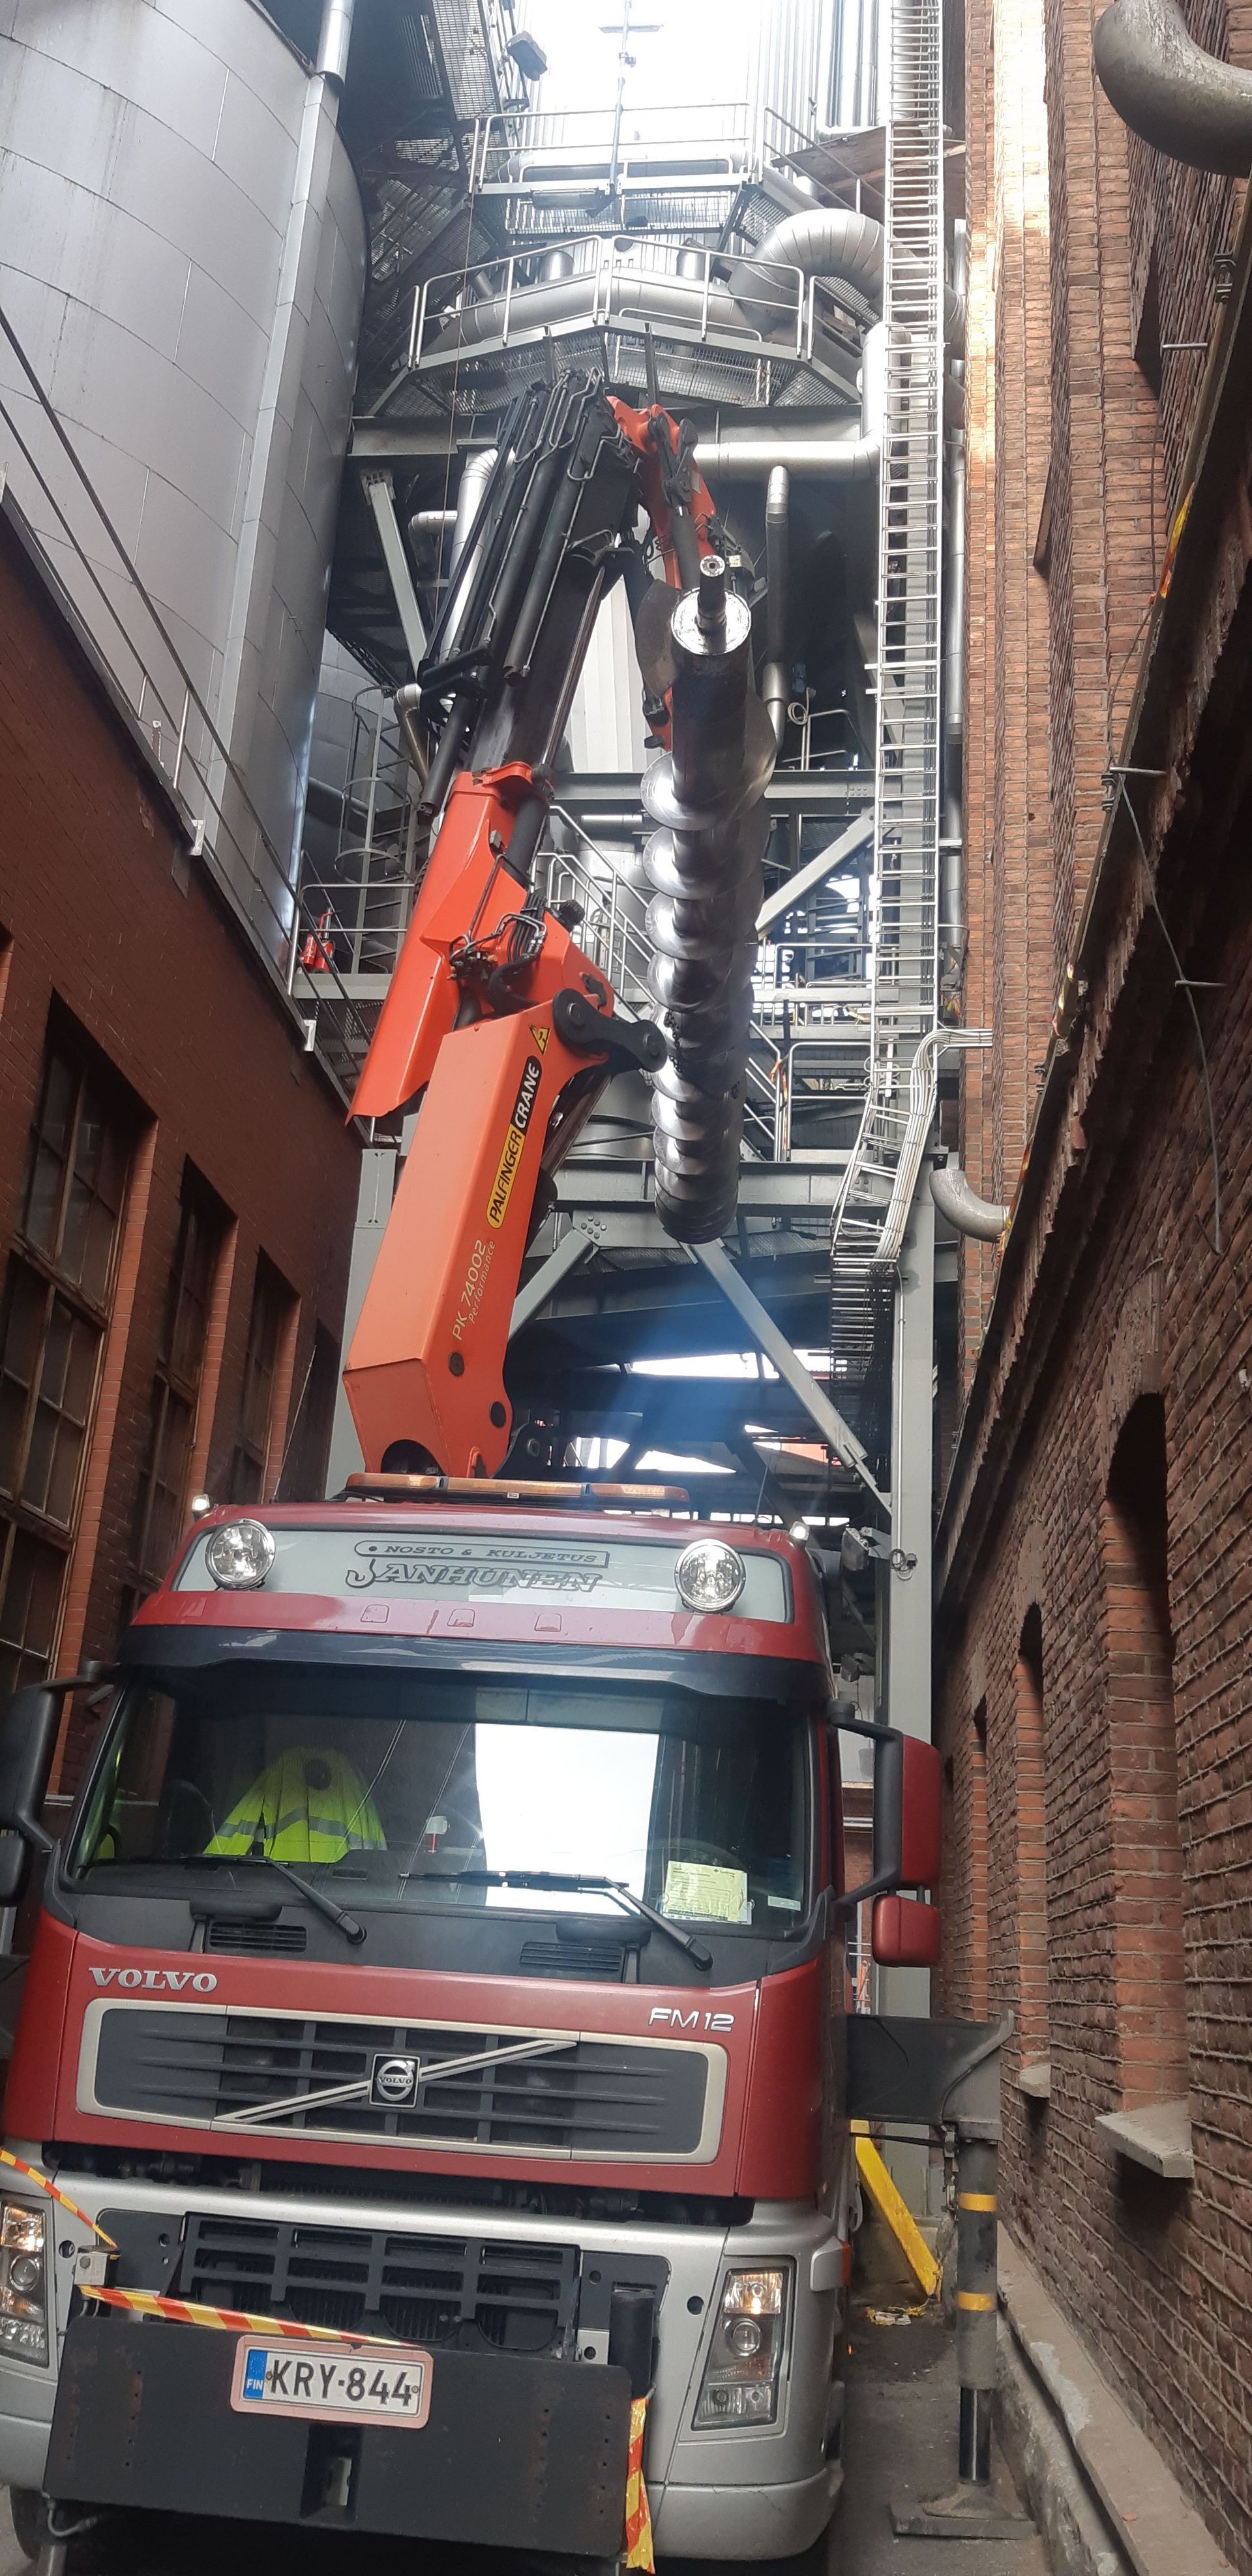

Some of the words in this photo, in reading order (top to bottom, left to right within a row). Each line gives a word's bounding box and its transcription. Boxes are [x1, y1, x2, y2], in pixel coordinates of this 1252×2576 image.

[489, 1130, 522, 1223] PALFINGER
[514, 1062, 539, 1129] CRANE
[452, 1310, 468, 1341] PK
[460, 1239, 486, 1308] 74002
[468, 1240, 495, 1324] Performance
[345, 1558, 603, 1593] JANHUNEN
[385, 1546, 454, 1555] NOSTO
[486, 1550, 597, 1563] KULJETUS
[88, 1967, 217, 1992] VOLVO
[246, 2379, 263, 2390] FIN
[271, 2359, 412, 2406] KRY-844
